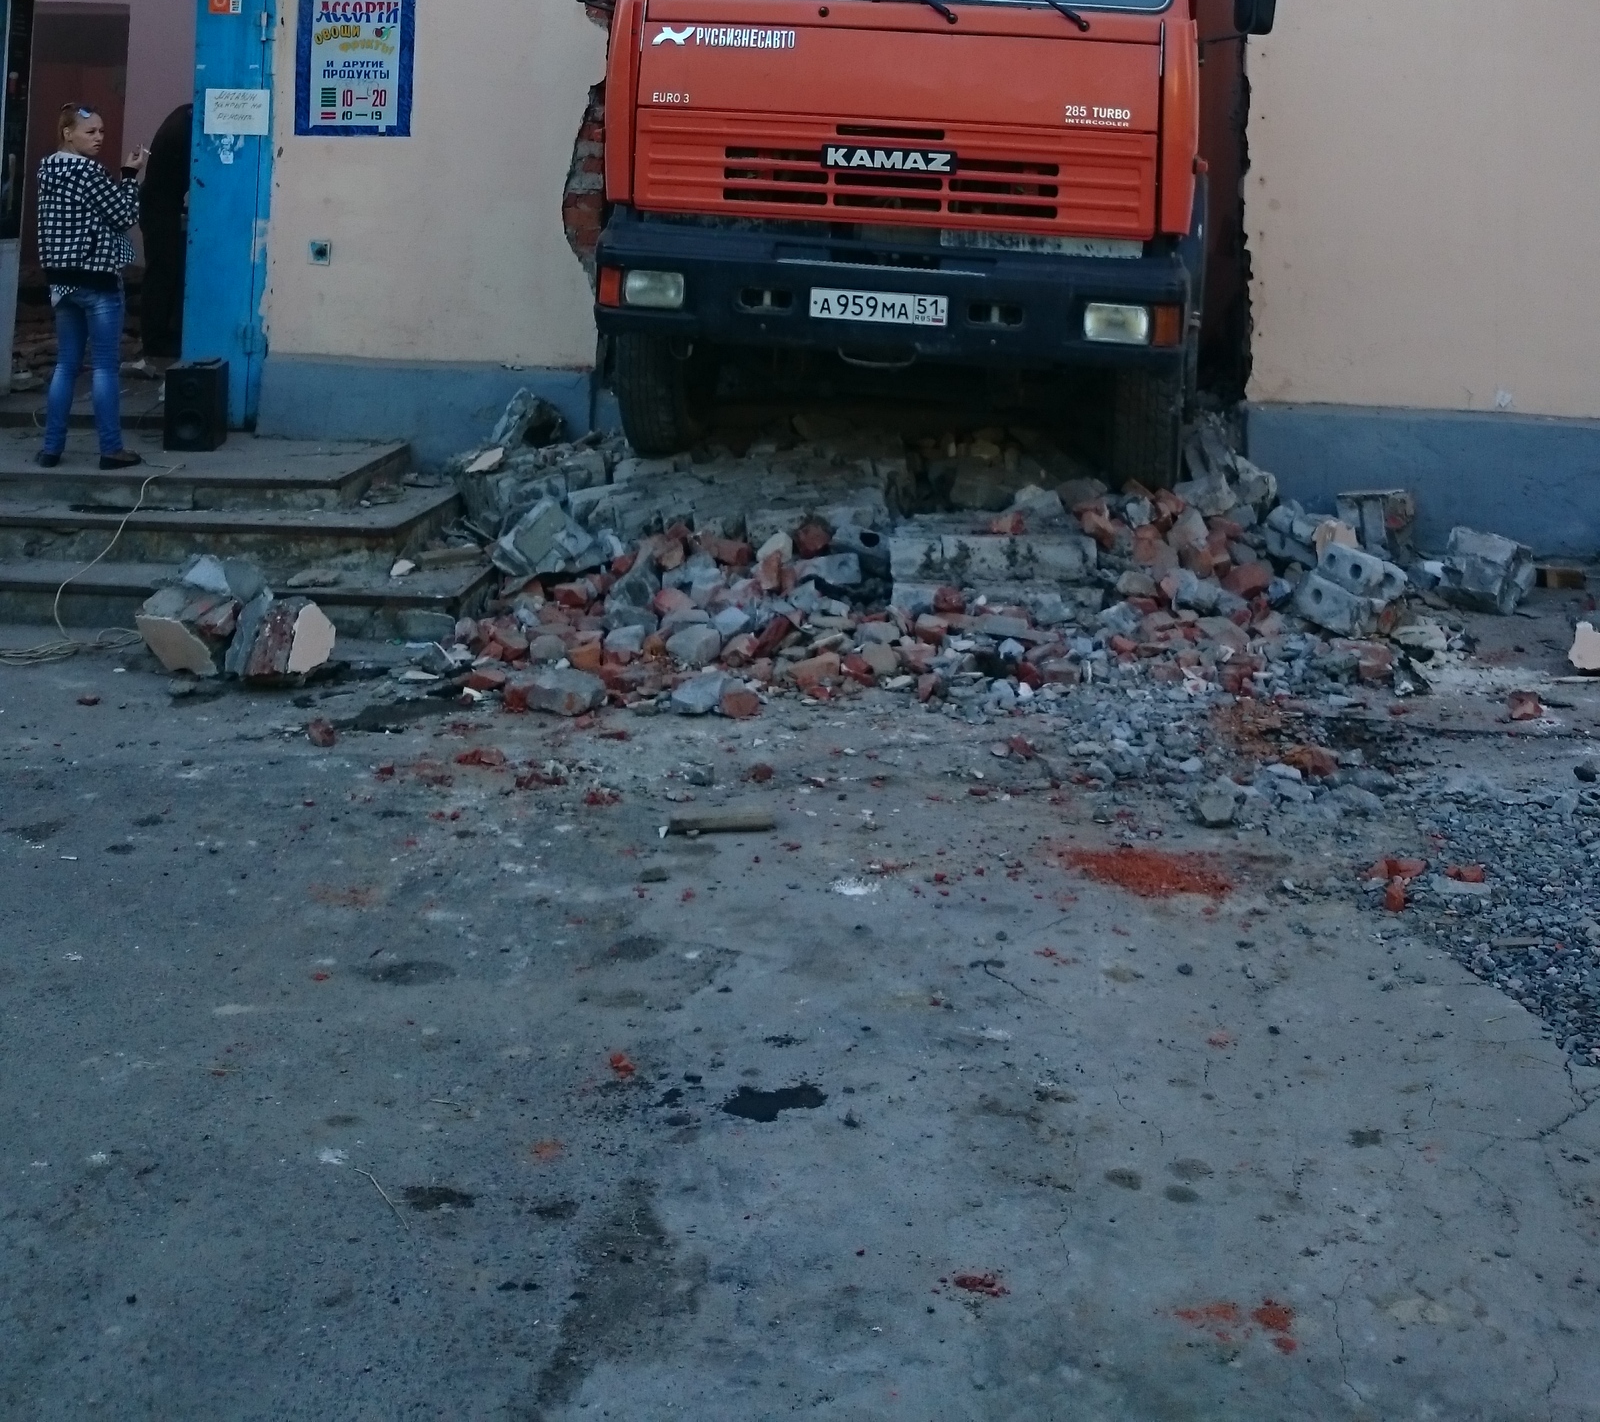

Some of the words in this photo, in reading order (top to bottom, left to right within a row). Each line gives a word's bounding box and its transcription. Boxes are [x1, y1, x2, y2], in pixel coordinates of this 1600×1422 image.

[316, 1, 399, 24] АССОРТИ
[696, 26, 796, 50] РУСБИЗНЕСАВТО
[326, 60, 334, 68] И
[342, 60, 385, 69] ДРУГИЕ
[322, 69, 390, 80] ПРОДУКТЫ
[652, 92, 681, 104] EURO
[683, 93, 690, 104] 3
[1065, 105, 1087, 117] 285
[1092, 106, 1131, 120] TURBO
[1065, 118, 1129, 127] INTERCOOLER
[826, 147, 951, 172] KAMAZ
[916, 298, 939, 316] 51
